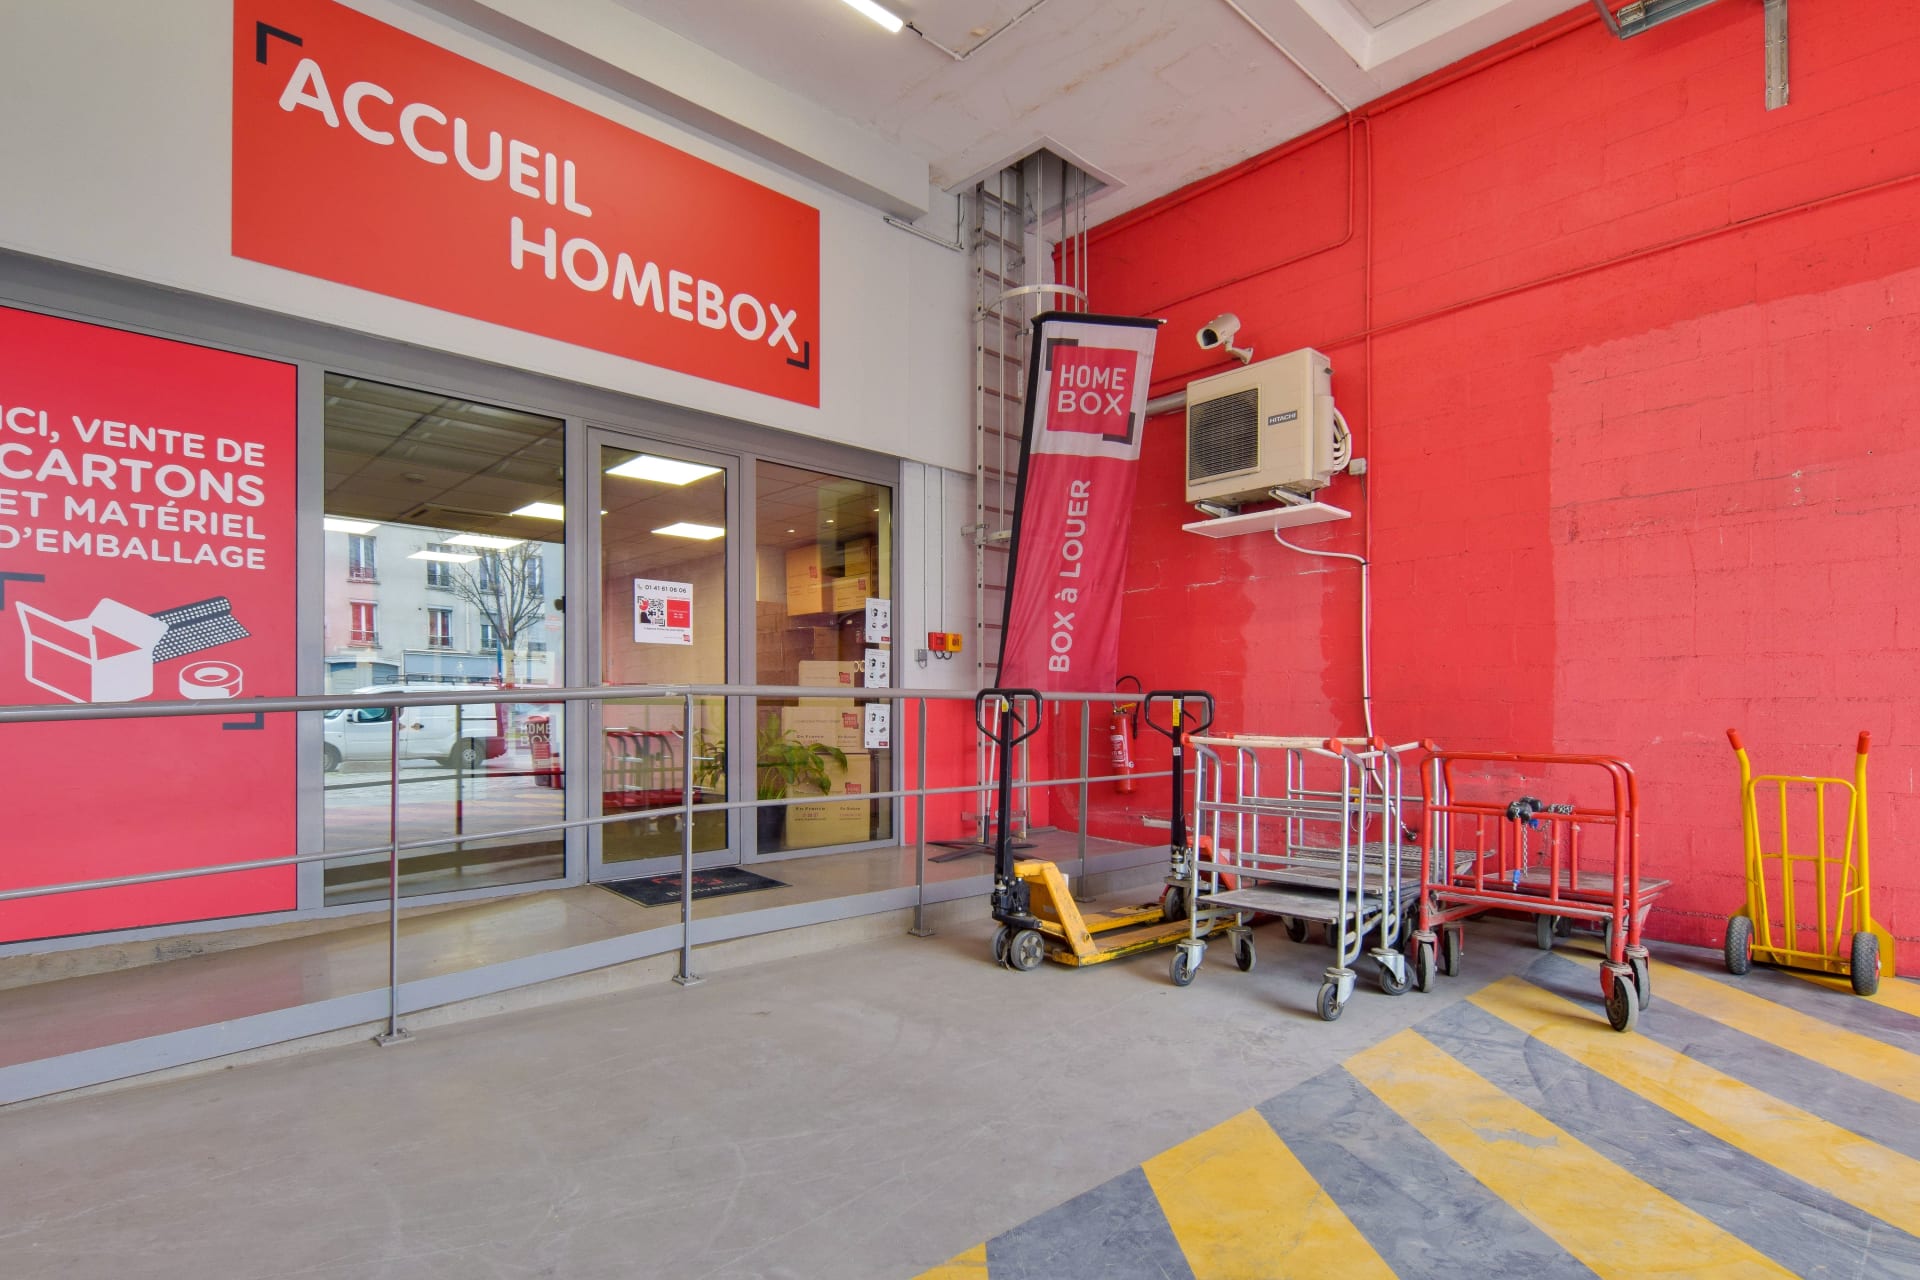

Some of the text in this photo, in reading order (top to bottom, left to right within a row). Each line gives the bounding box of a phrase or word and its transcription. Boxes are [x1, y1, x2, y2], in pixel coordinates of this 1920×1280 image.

[279, 58, 592, 217] ACCUEIL
[510, 216, 799, 354] HOMEBOX
[1057, 390, 1124, 416] BOX
[1060, 364, 1127, 390] HOME
[72, 415, 205, 459] VENTE
[217, 438, 265, 467] DE
[1269, 411, 1297, 424] HITACHI
[0, 442, 265, 507] CARTONS
[0, 488, 266, 540] ET MATÉRIEL
[1049, 479, 1091, 672] BOX à LOUER
